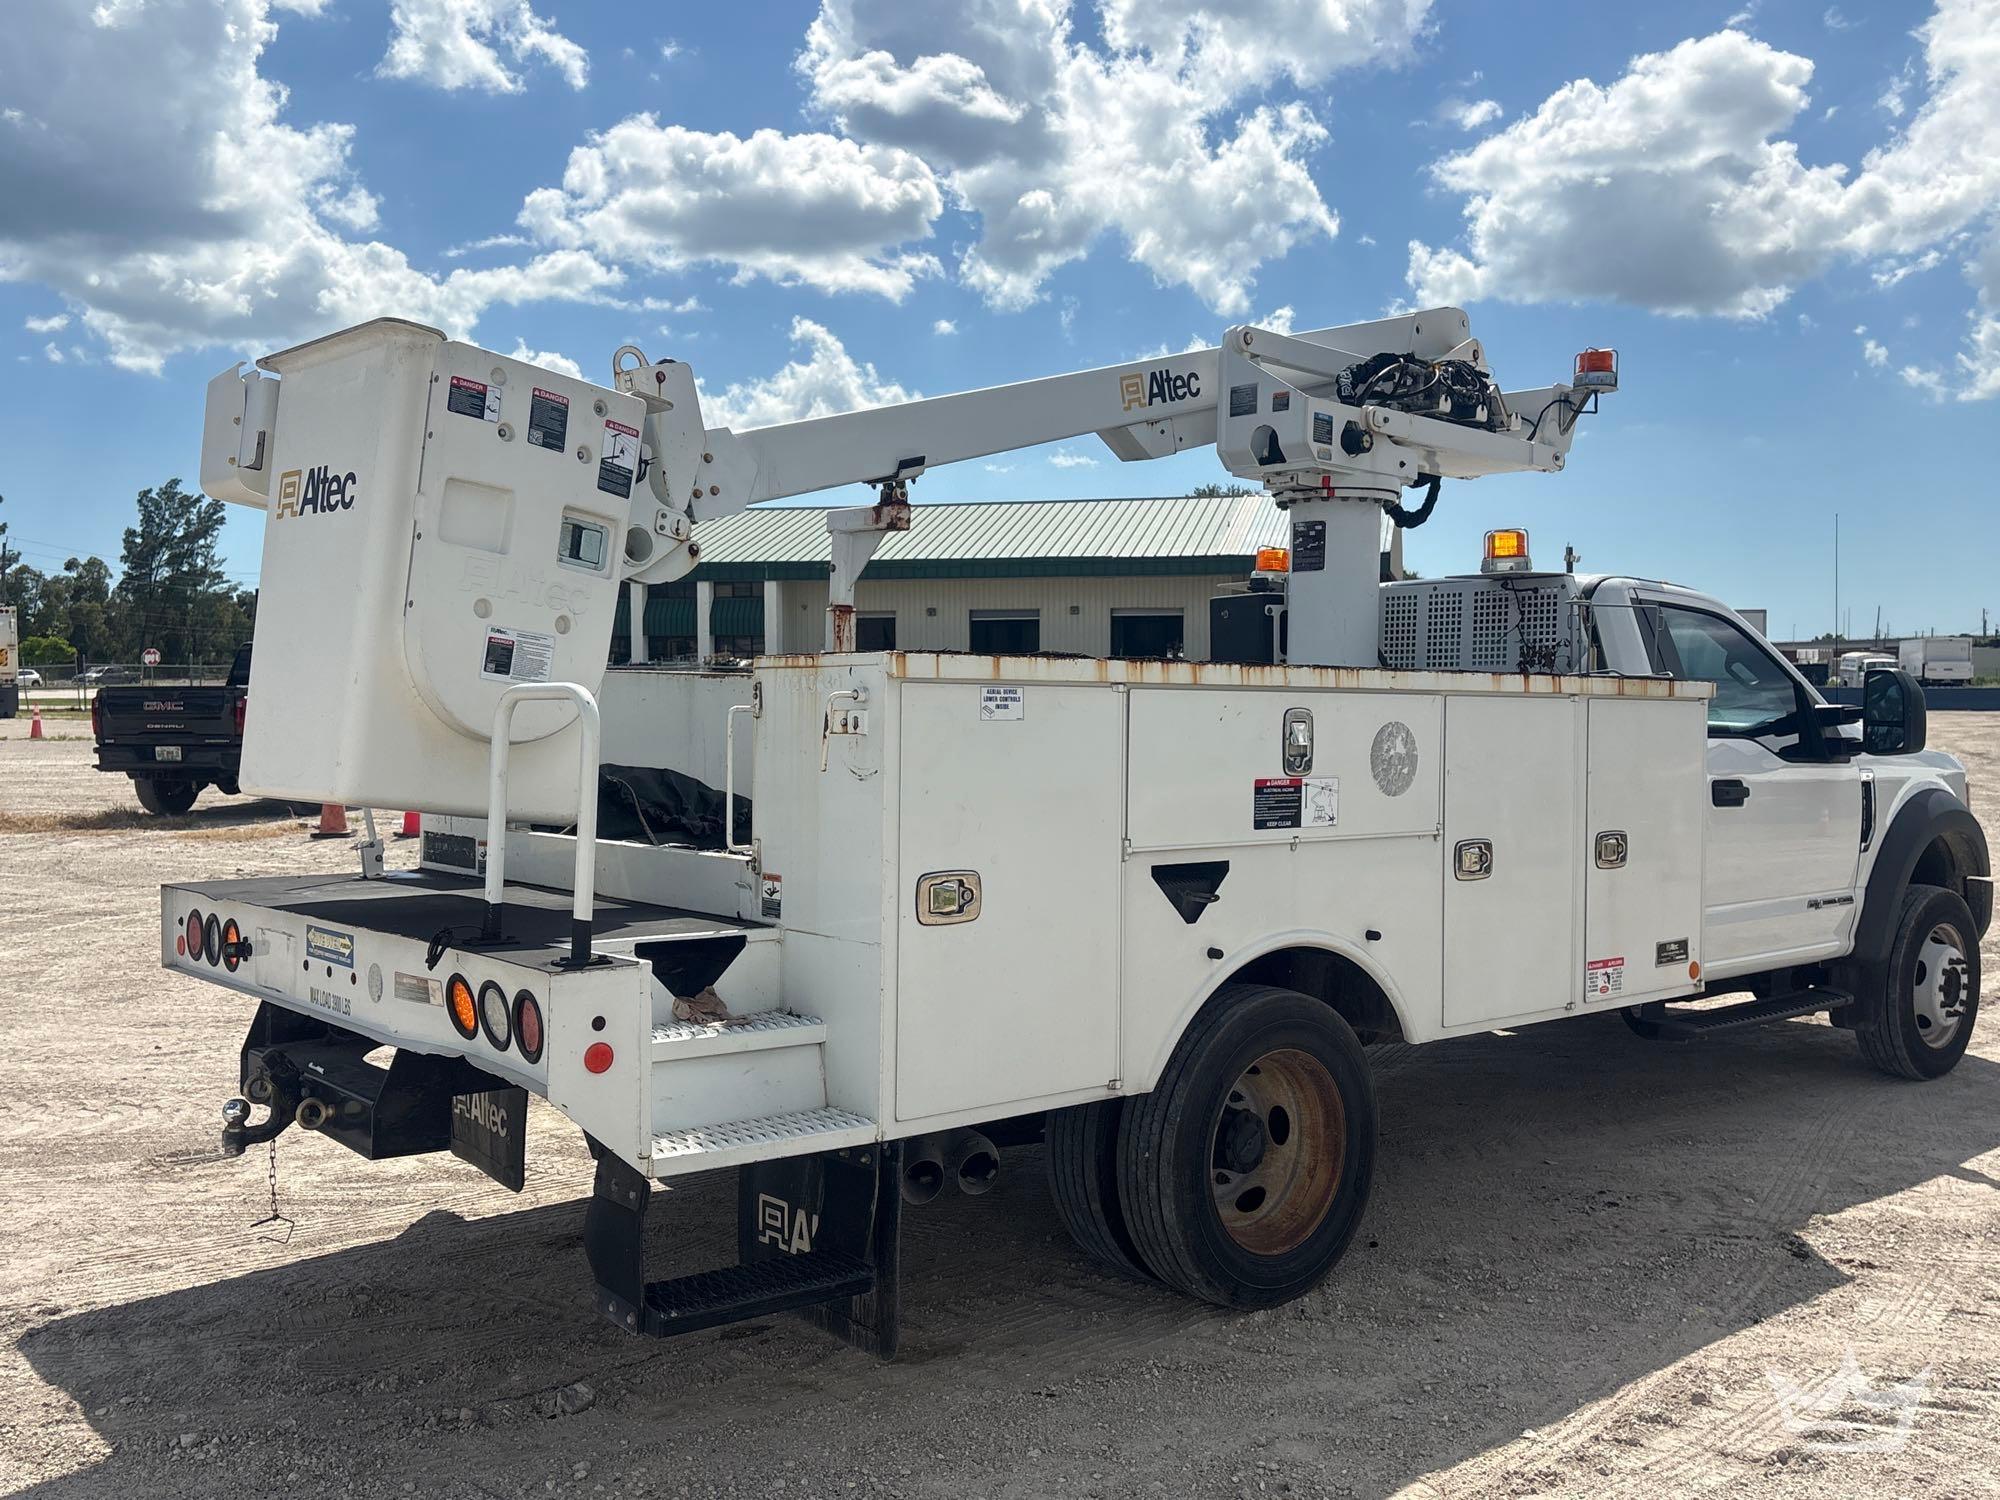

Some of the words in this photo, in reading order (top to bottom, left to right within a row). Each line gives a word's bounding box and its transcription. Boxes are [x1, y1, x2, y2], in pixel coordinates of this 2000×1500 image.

[460, 380, 484, 390] DANGER
[1148, 369, 1200, 407] Altec
[540, 391, 569, 405] DANGER
[614, 425, 638, 437] DANGER
[299, 465, 357, 517] Altec
[143, 701, 184, 711] GMC
[320, 990, 331, 1010] LOAD
[342, 997, 351, 1017] LBS
[471, 1091, 508, 1138] Altec
